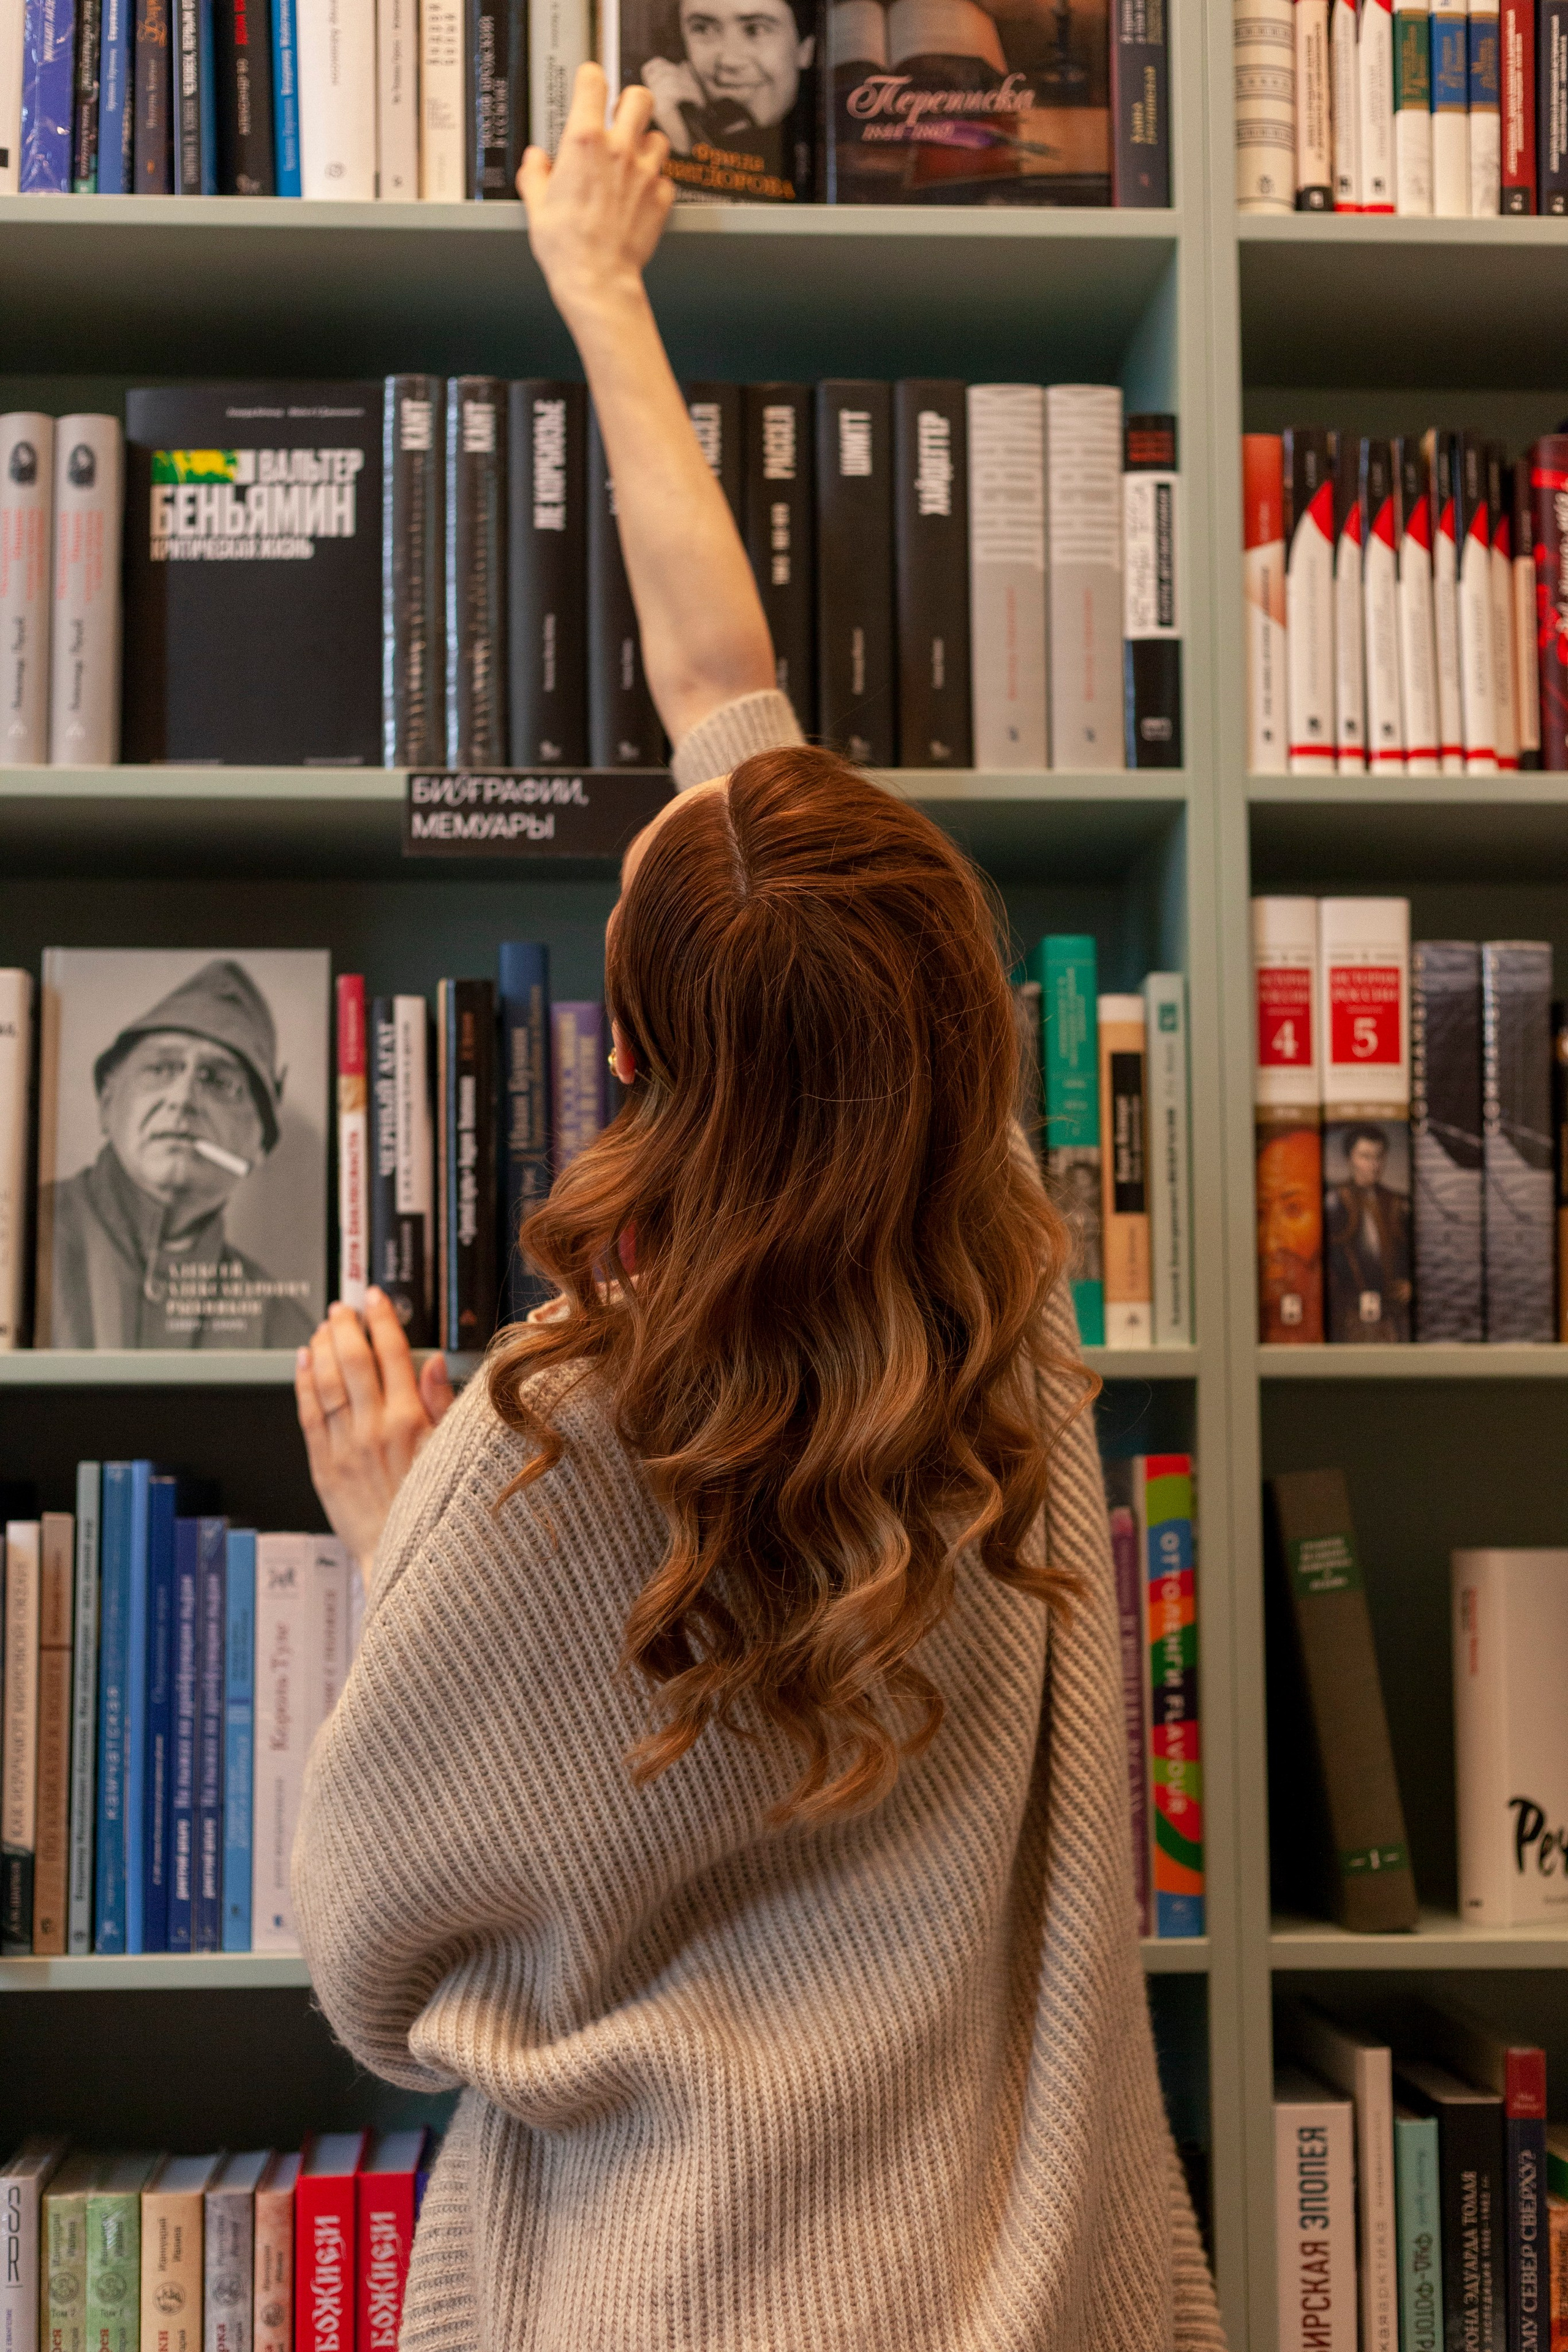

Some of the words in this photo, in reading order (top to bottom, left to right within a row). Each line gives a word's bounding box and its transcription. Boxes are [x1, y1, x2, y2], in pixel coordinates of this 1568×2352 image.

[845, 72, 1036, 127] Переписка
[258, 448, 364, 484] ВАЛЬТЕР
[532, 398, 567, 503] КОРБЮЗЬЕ
[688, 402, 722, 478] АССЕЛ
[839, 409, 872, 477] ШМИТТ
[914, 410, 954, 516] ХАЙДЕГГЕР
[149, 484, 356, 538] БЕНЬЯМИН
[532, 504, 566, 531] ЛЕ
[411, 810, 556, 840] МЕМУАРЫ
[377, 1020, 396, 1076] АГАТ
[1271, 1019, 1300, 1060] 4
[1351, 1016, 1379, 1058] 5
[1159, 1532, 1185, 1689] ОТТОЛЕНГИ
[271, 1621, 293, 1669] Туле
[269, 1675, 291, 1752] Король
[1162, 1693, 1188, 1815] FLAVOUR
[1297, 2127, 1330, 2231] ЭПОПЕЯ
[1461, 2171, 1479, 2226] ТОЛЛЯ
[1518, 2149, 1538, 2241] СВЕРХУ?
[1412, 2232, 1436, 2352] ФУД-ФОТОГР
[1462, 2229, 1481, 2305] ЭДУАРДА
[1521, 2244, 1538, 2313] СЕВЕР
